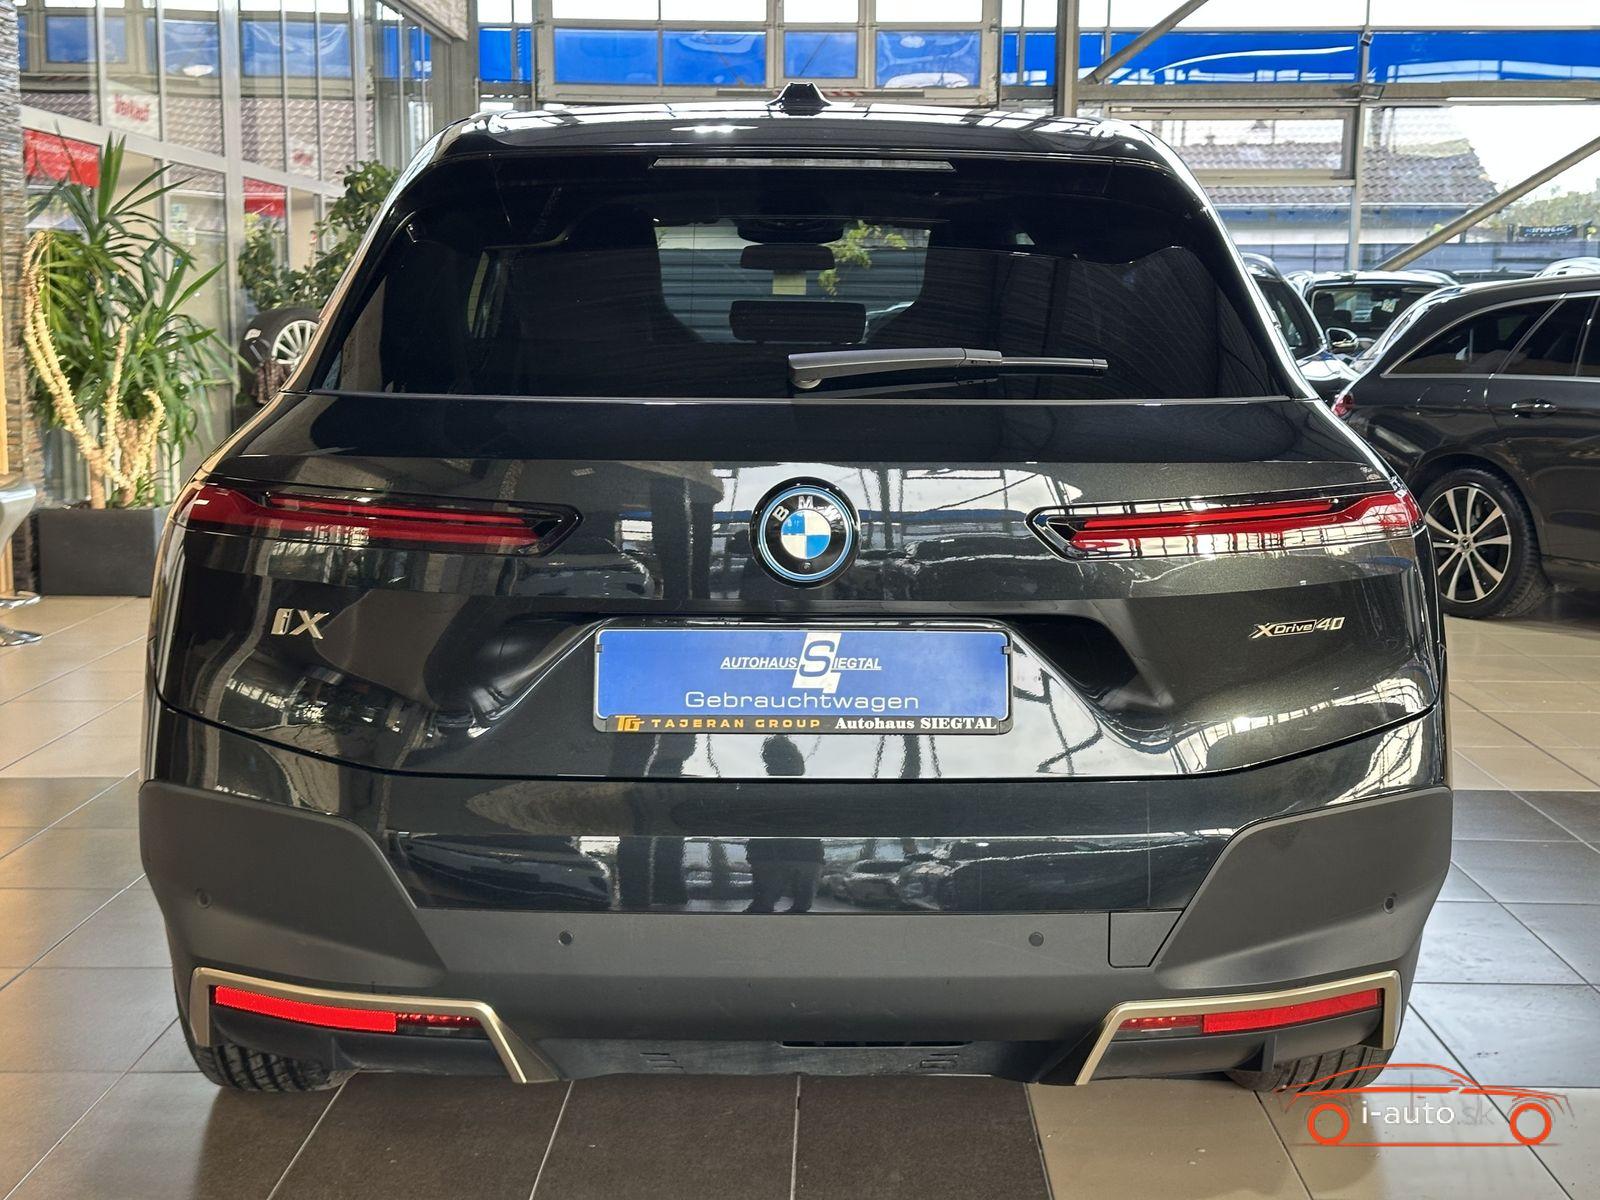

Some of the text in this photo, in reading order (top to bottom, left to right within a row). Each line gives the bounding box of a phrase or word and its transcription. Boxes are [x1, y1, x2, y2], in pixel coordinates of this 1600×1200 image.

[772, 495, 842, 522] BMW
[720, 656, 798, 669] AUTOHAUS
[685, 690, 919, 712] Gebrauchtwagen
[651, 718, 744, 729] TAJERAN
[755, 718, 821, 729] GROUP
[834, 717, 915, 730] Autohaus
[920, 716, 997, 730] SIEGTAL
